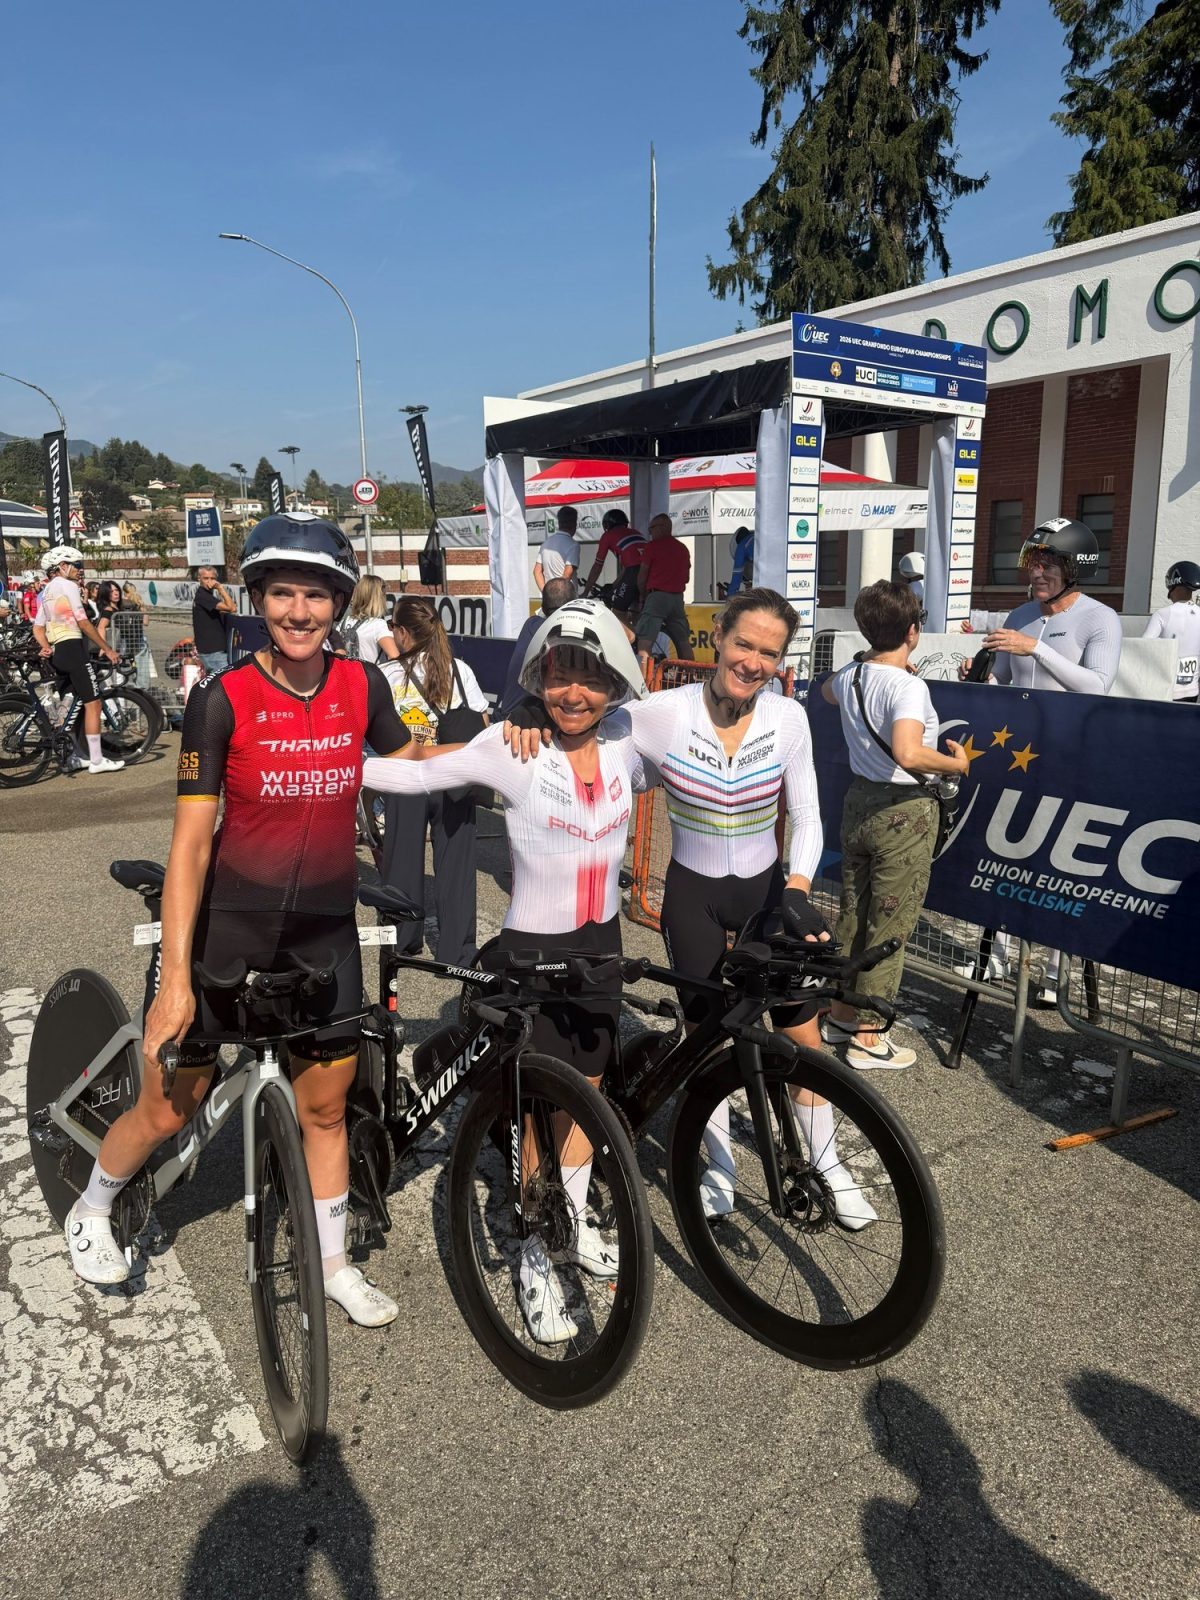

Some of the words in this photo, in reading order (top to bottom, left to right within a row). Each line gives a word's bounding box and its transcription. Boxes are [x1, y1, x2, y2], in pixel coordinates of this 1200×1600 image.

[812, 331, 830, 341] UEC
[839, 335, 852, 344] 2026
[852, 337, 862, 345] UEC
[862, 340, 890, 351] GRANFONDO
[890, 345, 914, 355] EUROPEAN
[914, 350, 952, 361] CHAMPIONSHIPS
[860, 369, 875, 382] UCI
[682, 506, 709, 518] e-work
[719, 507, 756, 518] SPECIALIZ
[824, 507, 854, 515] elmec
[872, 504, 896, 515] MAPEI
[907, 503, 928, 511] FS
[953, 527, 972, 535] challenge
[271, 711, 294, 720] EPRO
[413, 725, 432, 735] LEMON
[694, 749, 722, 770] UCI
[549, 808, 629, 842] POLSKA
[985, 788, 1200, 895] UEC
[977, 858, 1033, 884] UNION
[1035, 874, 1170, 920] EUROPÉENNE
[970, 874, 995, 892] DE
[996, 881, 1087, 918] CYCLISME
[535, 961, 568, 971] aerocoach
[446, 965, 496, 984] SPECIALIZED
[406, 1023, 491, 1137] S-WORKS
[177, 1081, 230, 1163] BMC
